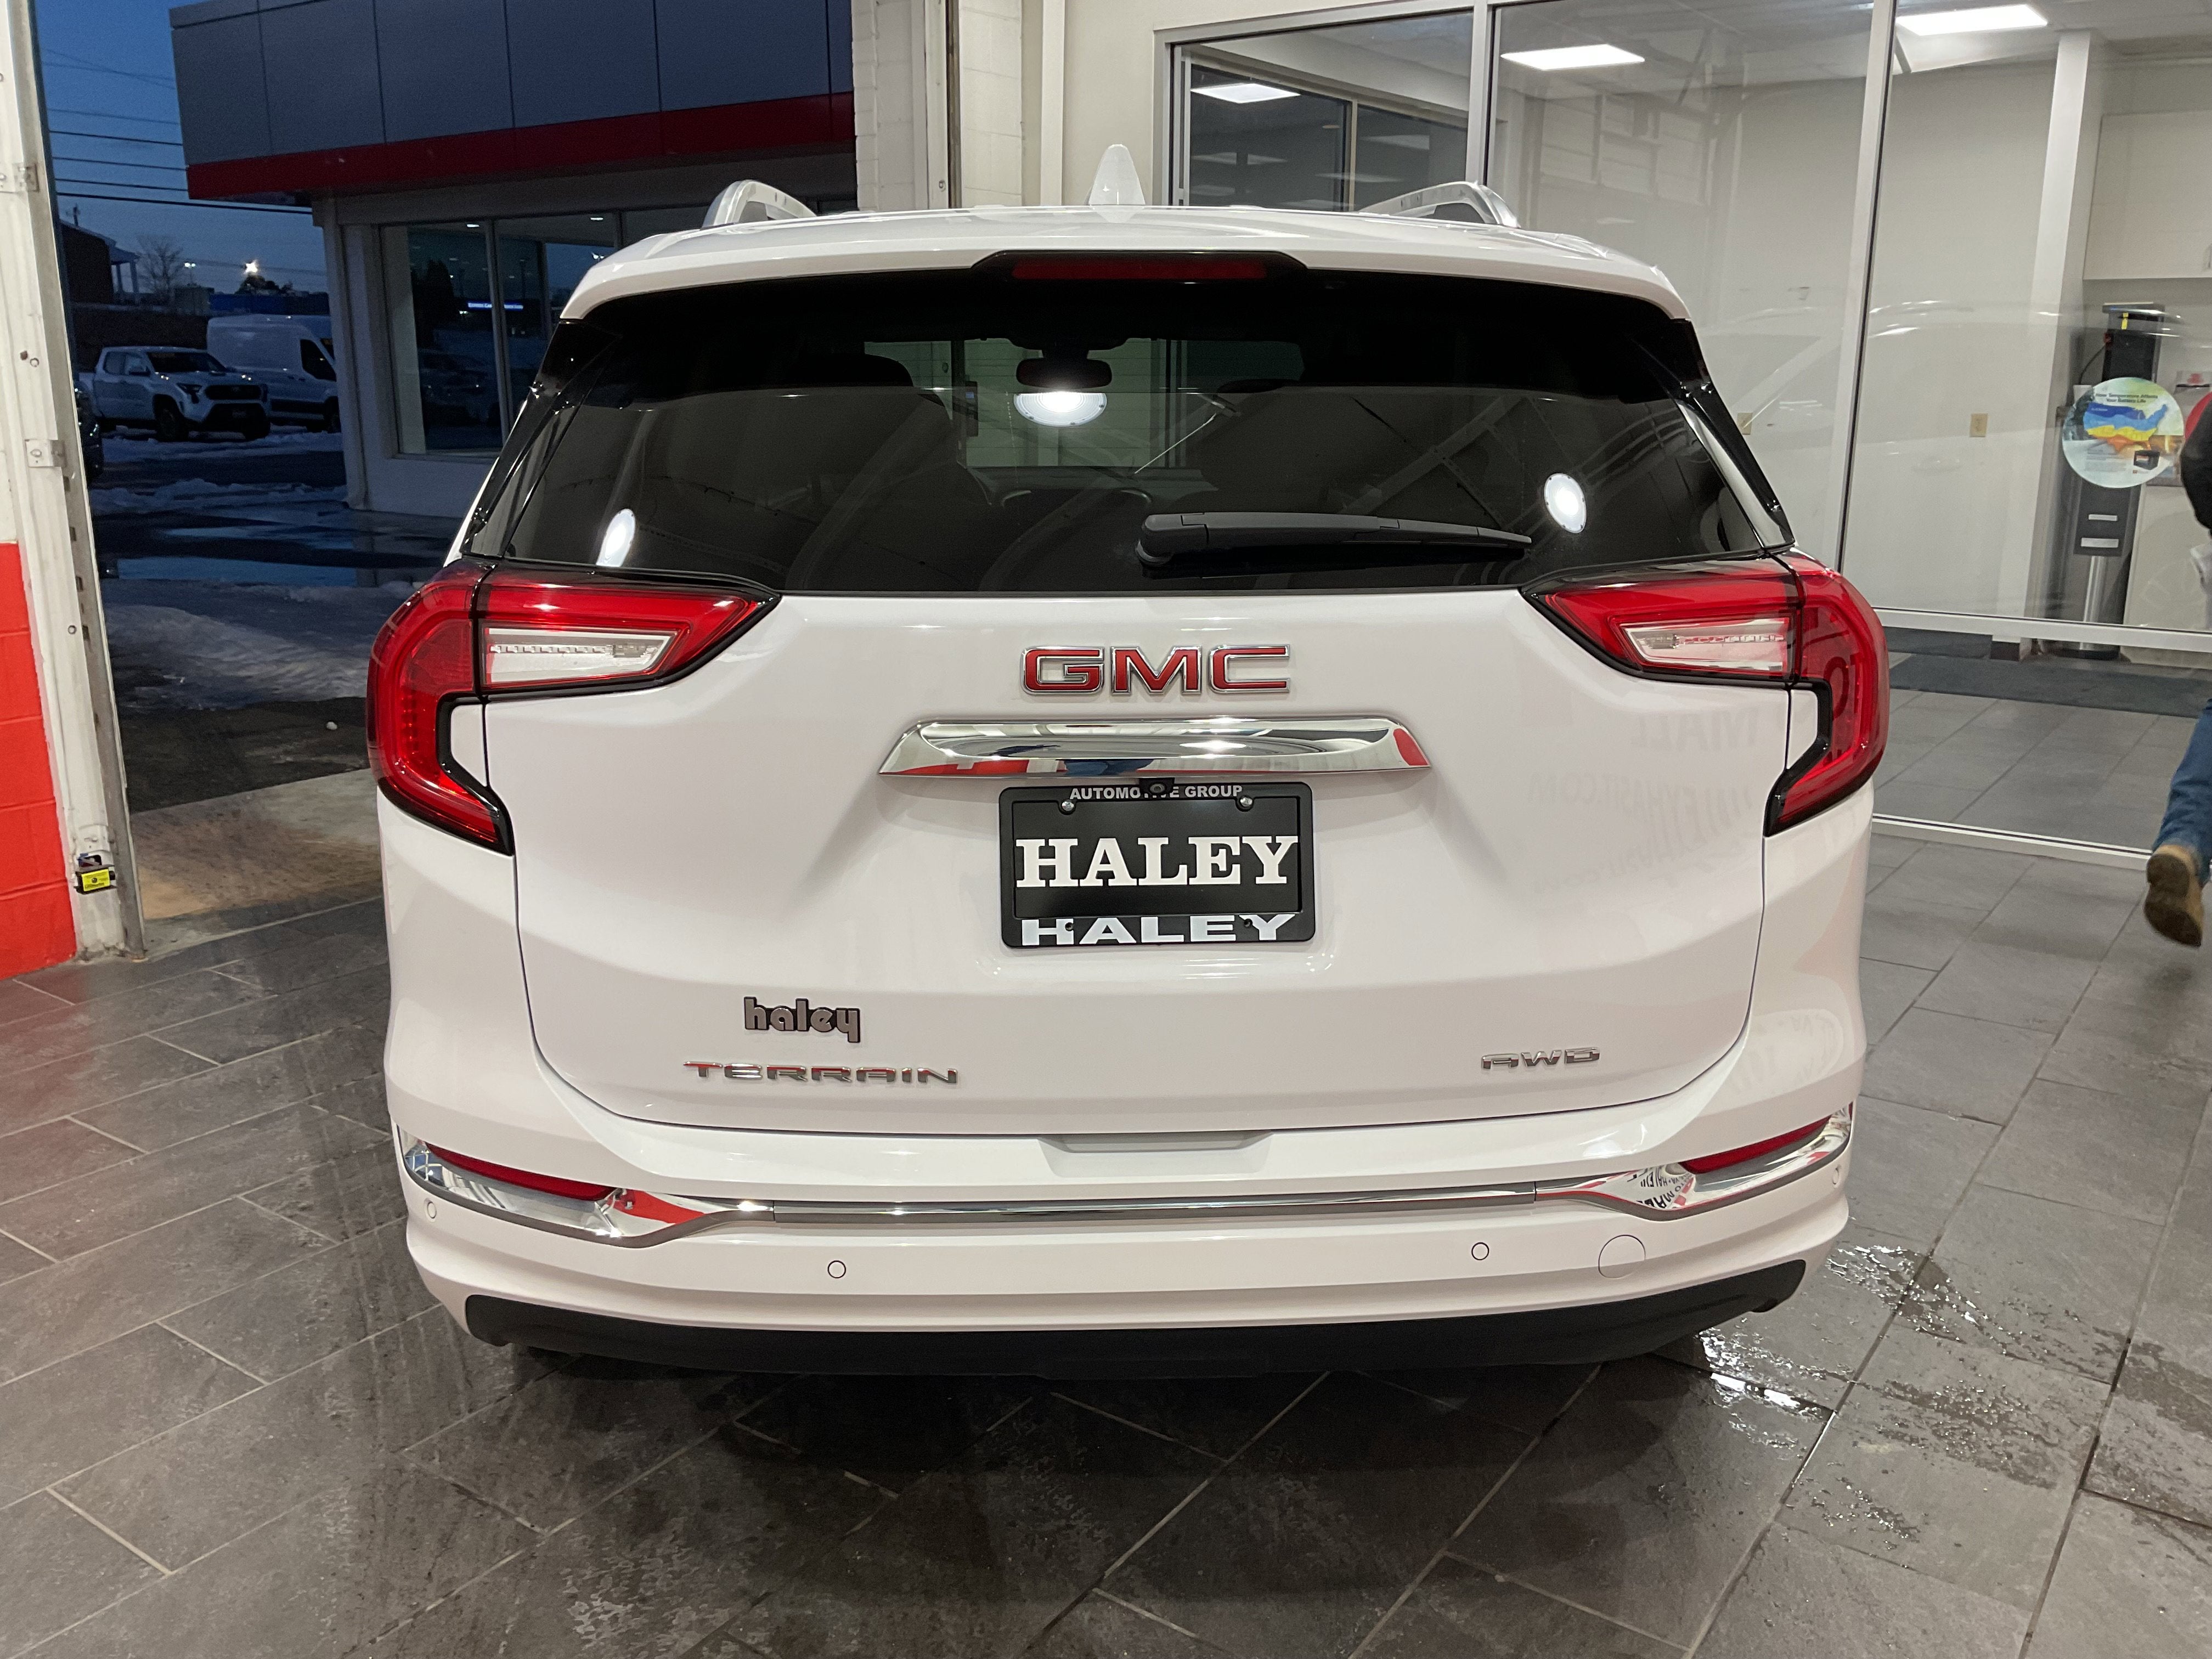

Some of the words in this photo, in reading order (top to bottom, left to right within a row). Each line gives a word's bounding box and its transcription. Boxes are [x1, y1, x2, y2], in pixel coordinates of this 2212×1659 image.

[1021, 644, 1291, 695] GMC
[1070, 786, 1180, 800] AUTOMOE
[1184, 785, 1243, 798] GROUP
[1015, 836, 1299, 888] HALEY
[1022, 913, 1296, 946] HALEY
[743, 996, 861, 1043] haley
[682, 1061, 958, 1084] TERRAIN
[1481, 1046, 1600, 1070] AWD
